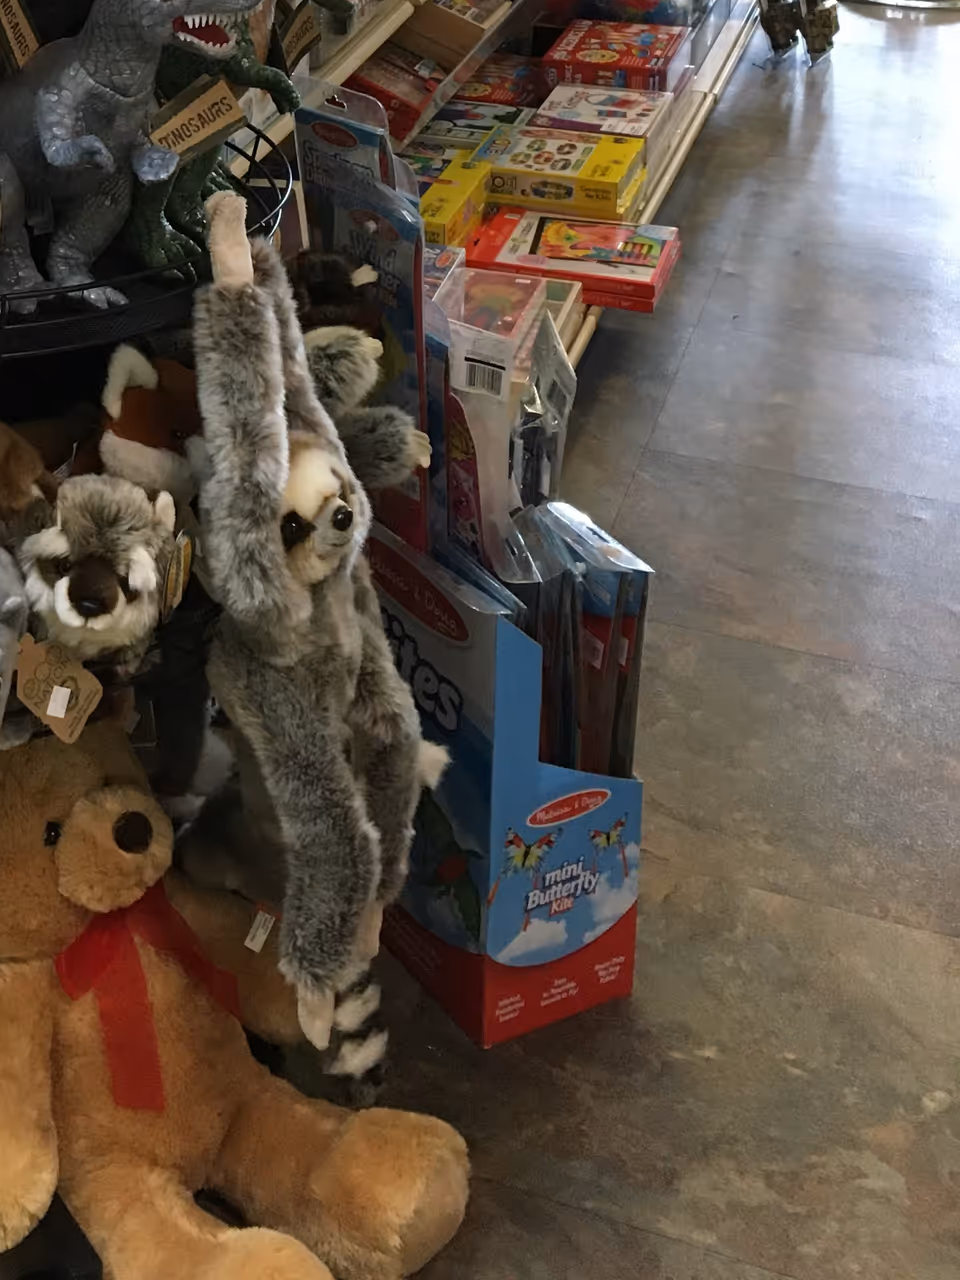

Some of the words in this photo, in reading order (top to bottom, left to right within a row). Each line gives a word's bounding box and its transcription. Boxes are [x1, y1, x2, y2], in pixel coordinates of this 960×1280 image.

[381, 606, 463, 730] ites
[544, 855, 585, 887] mini
[526, 869, 599, 911] Butterfly
[550, 898, 574, 916] Kite
